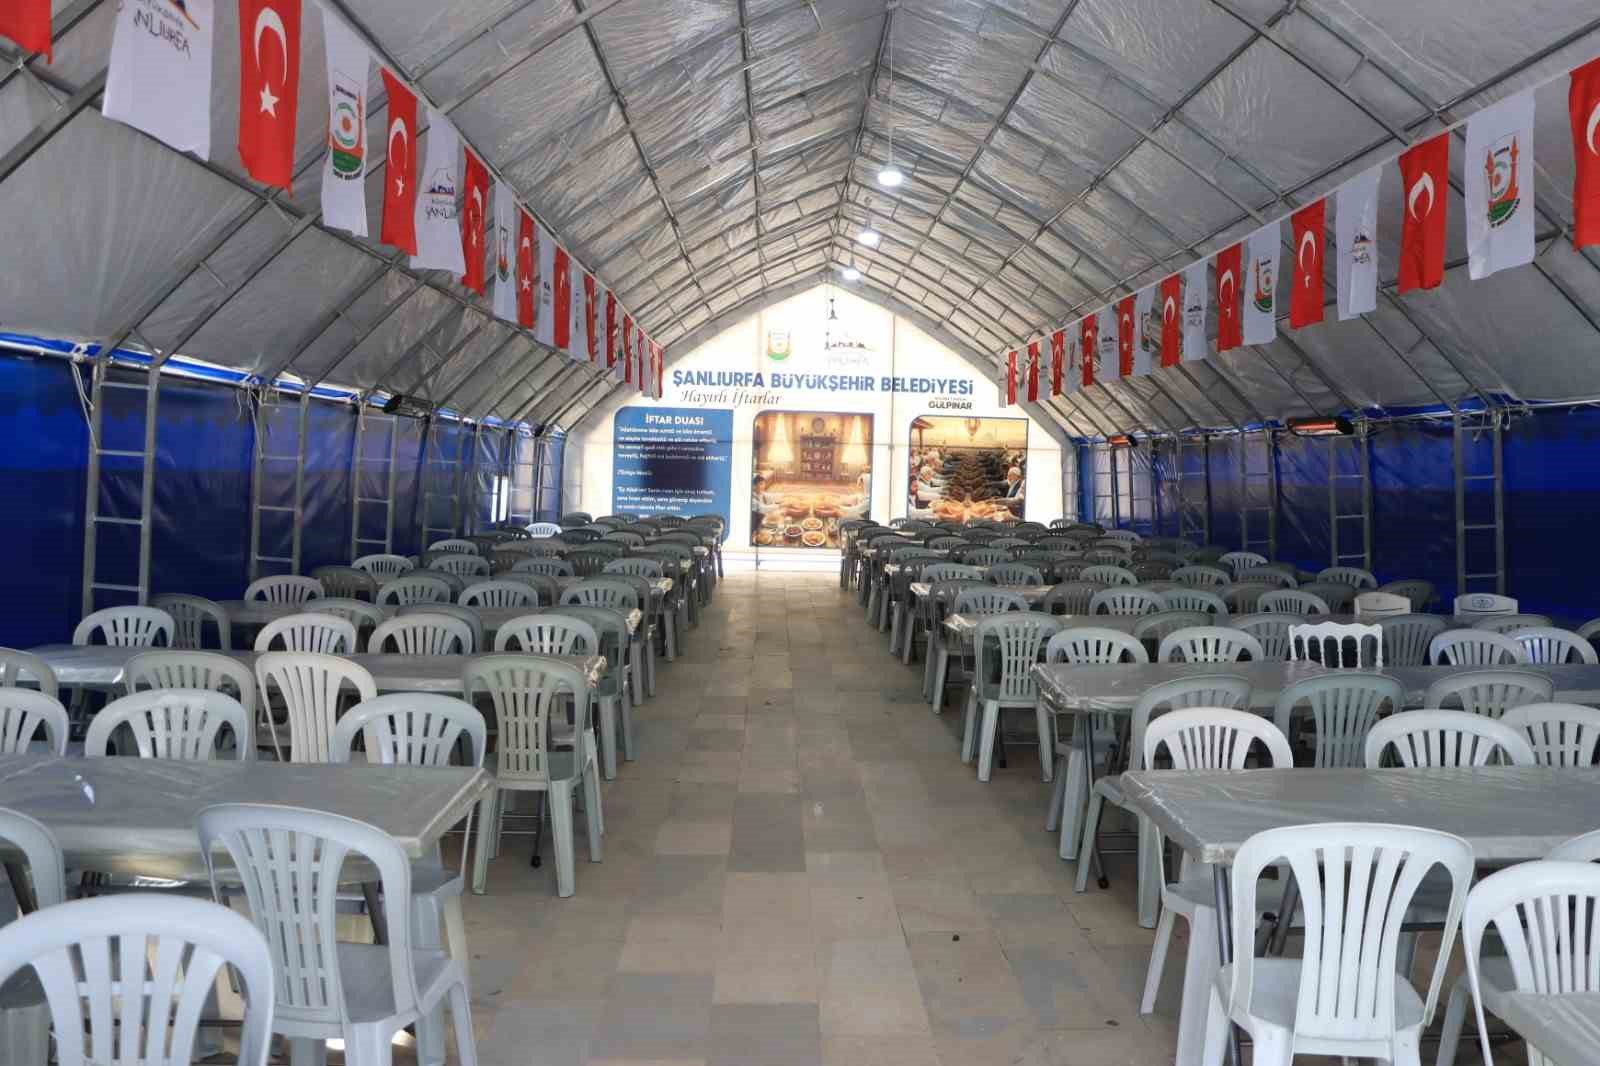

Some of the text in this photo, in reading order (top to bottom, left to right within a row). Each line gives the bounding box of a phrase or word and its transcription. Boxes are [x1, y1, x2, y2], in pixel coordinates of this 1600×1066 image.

[673, 370, 974, 395] ŞANLIURFA BÜYÜKŞEHİR BELEDİYESİ
[645, 413, 672, 425] İFTAR
